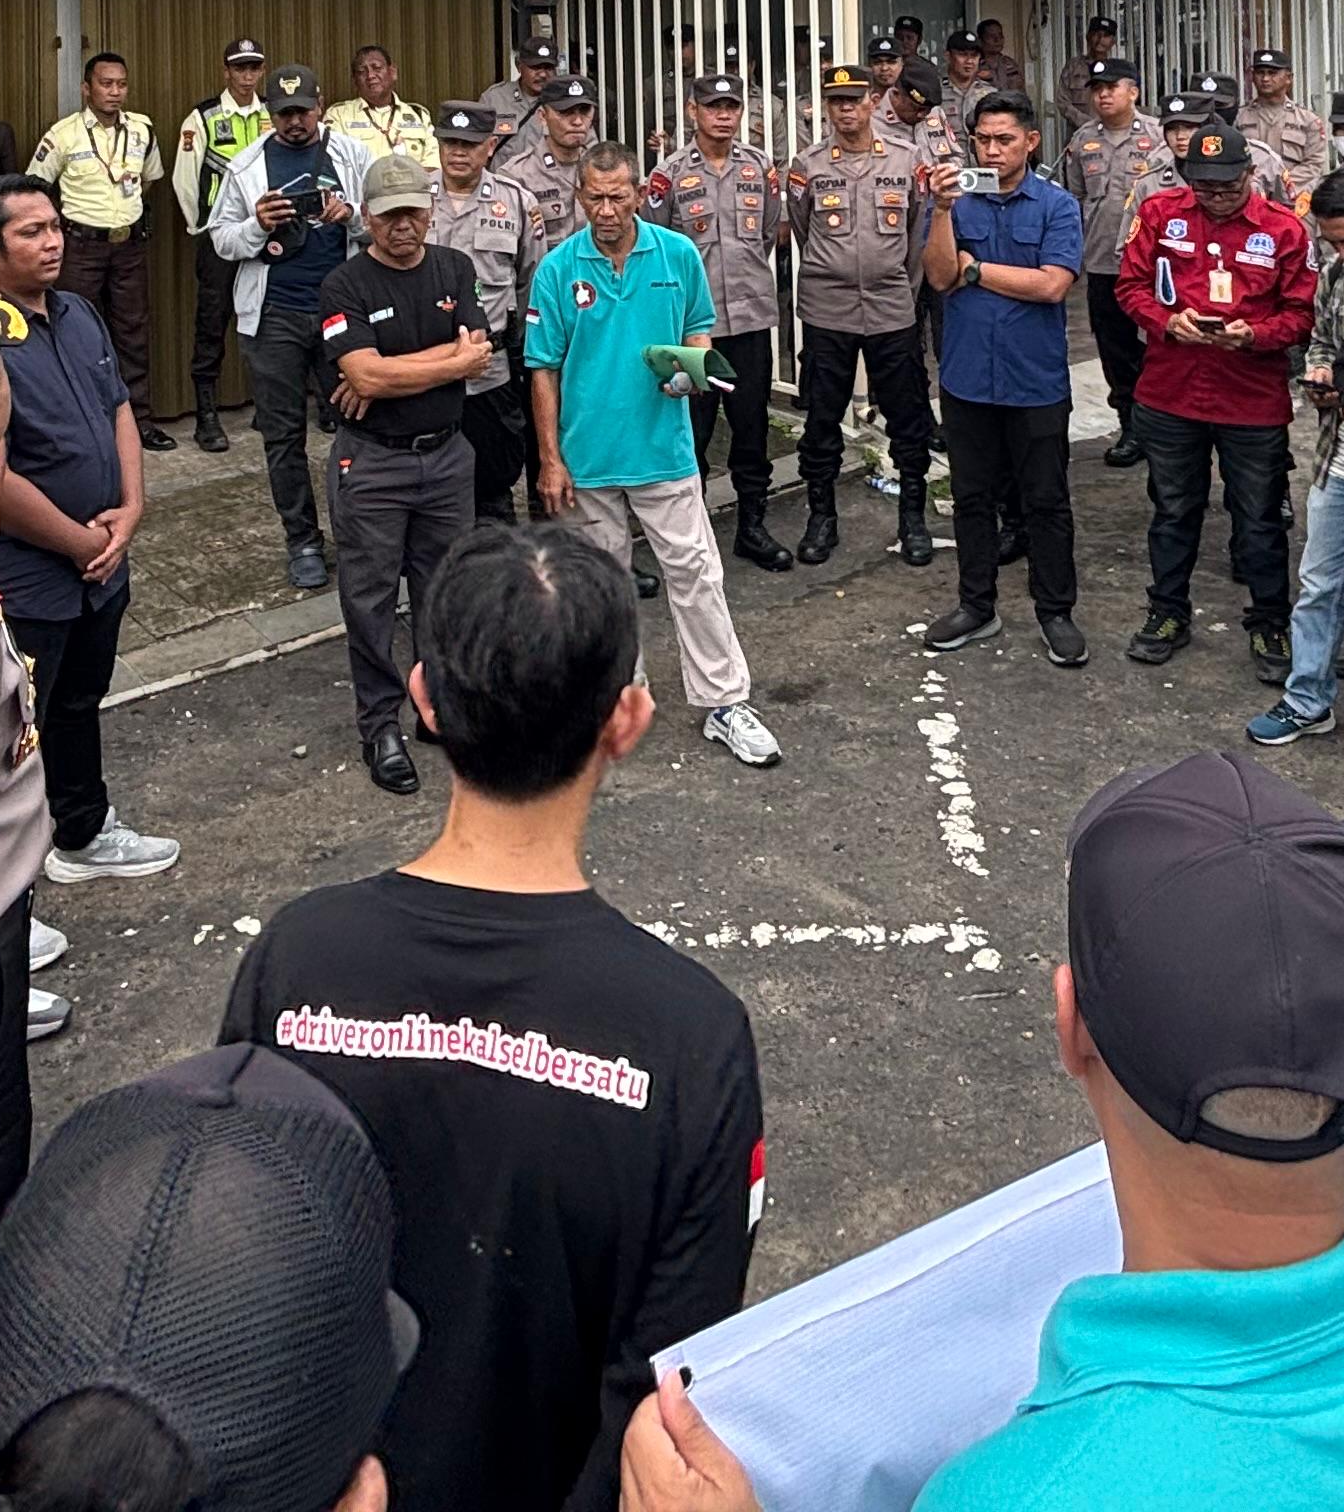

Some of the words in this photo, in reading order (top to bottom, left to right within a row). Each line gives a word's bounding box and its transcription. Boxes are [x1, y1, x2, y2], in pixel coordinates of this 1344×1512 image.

[875, 177, 906, 187] POLRI
[480, 217, 515, 230] POLRI
[278, 1008, 648, 1106] #driveronlinekalselbersatu
